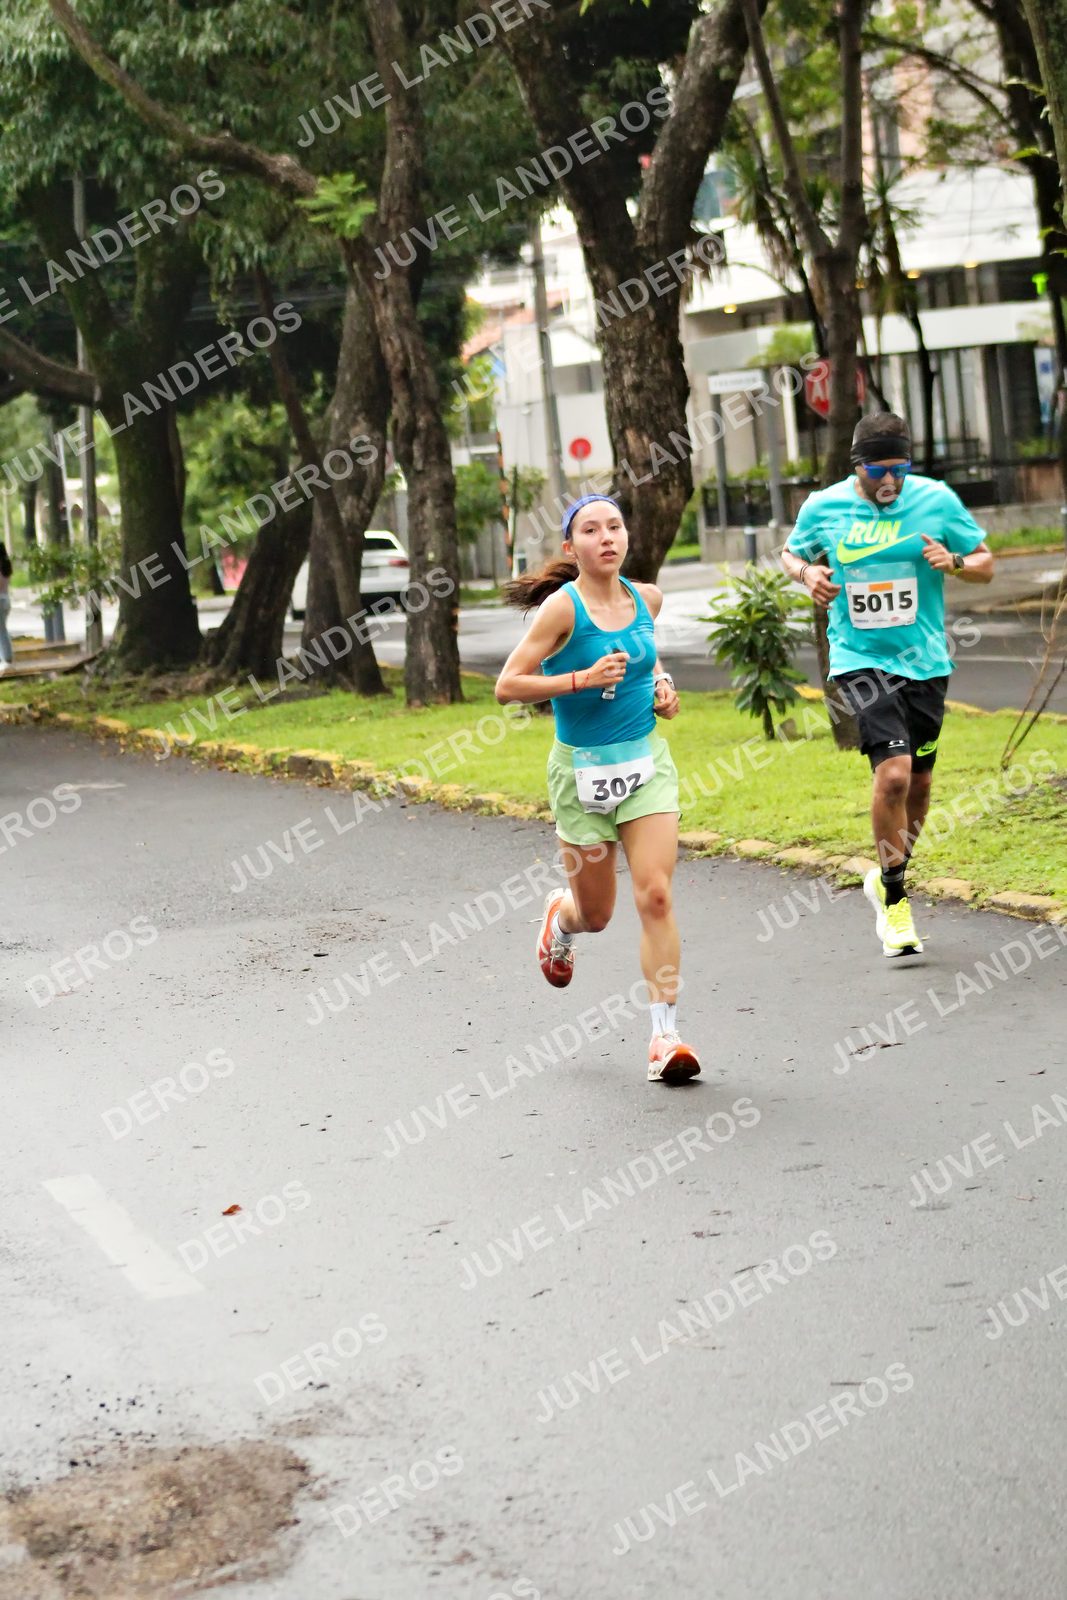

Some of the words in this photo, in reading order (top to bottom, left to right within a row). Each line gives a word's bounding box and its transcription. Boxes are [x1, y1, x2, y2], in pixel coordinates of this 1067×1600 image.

[846, 520, 902, 544] RUN
[852, 590, 913, 613] 5015
[592, 772, 643, 801] 302
